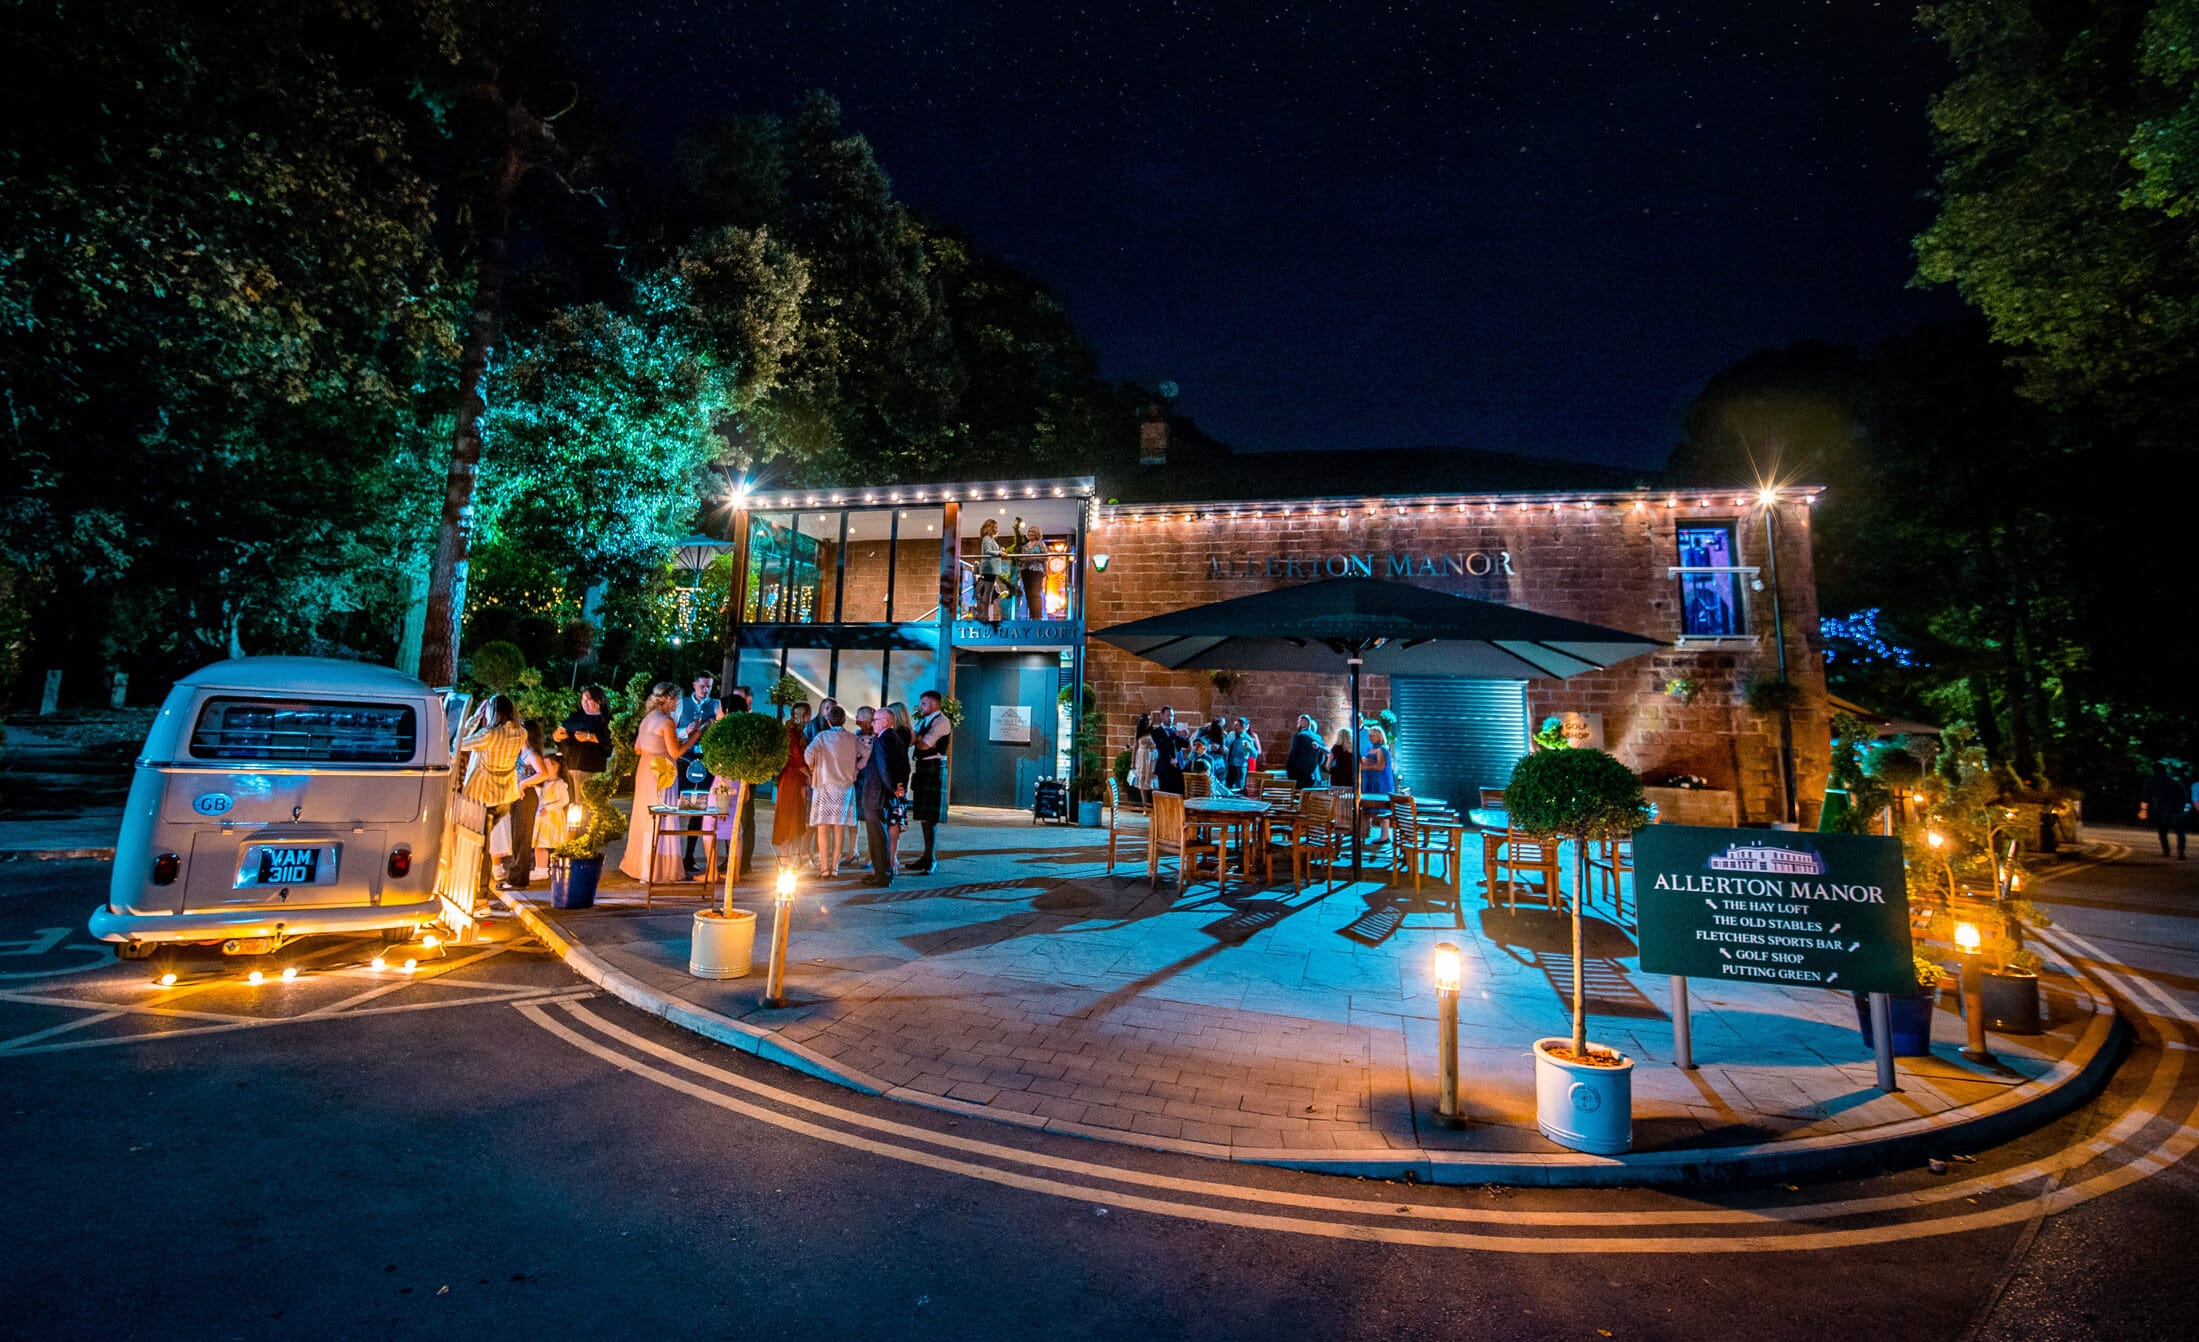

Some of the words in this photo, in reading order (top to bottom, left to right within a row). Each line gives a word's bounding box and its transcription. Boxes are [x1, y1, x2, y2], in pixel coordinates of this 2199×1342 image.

[1205, 553, 1374, 579] ALLERTON
[1386, 551, 1516, 577] MANOR
[958, 626, 991, 640] THE
[999, 626, 1031, 640] HAY
[1036, 626, 1080, 640] LOFT
[201, 797, 226, 811] GB
[270, 849, 312, 866] VAM
[267, 866, 307, 883] 311D
[1654, 873, 1783, 897] ALLERTON
[1790, 882, 1886, 904] MANOR
[1722, 899, 1746, 911] THE
[1749, 901, 1774, 913] HAY
[1777, 903, 1810, 915] LOFT
[1713, 915, 1738, 927] THE
[1740, 916, 1766, 928] OLD
[1768, 919, 1823, 932] STABLES
[1696, 930, 1765, 945] FLETCHERS
[1767, 935, 1814, 949] SPORTS
[1816, 938, 1843, 950] BAR
[1736, 949, 1769, 961] GOLF
[1771, 952, 1805, 964] SHOP
[1722, 964, 1776, 979] PUTTING
[1778, 969, 1822, 982] GREEN
